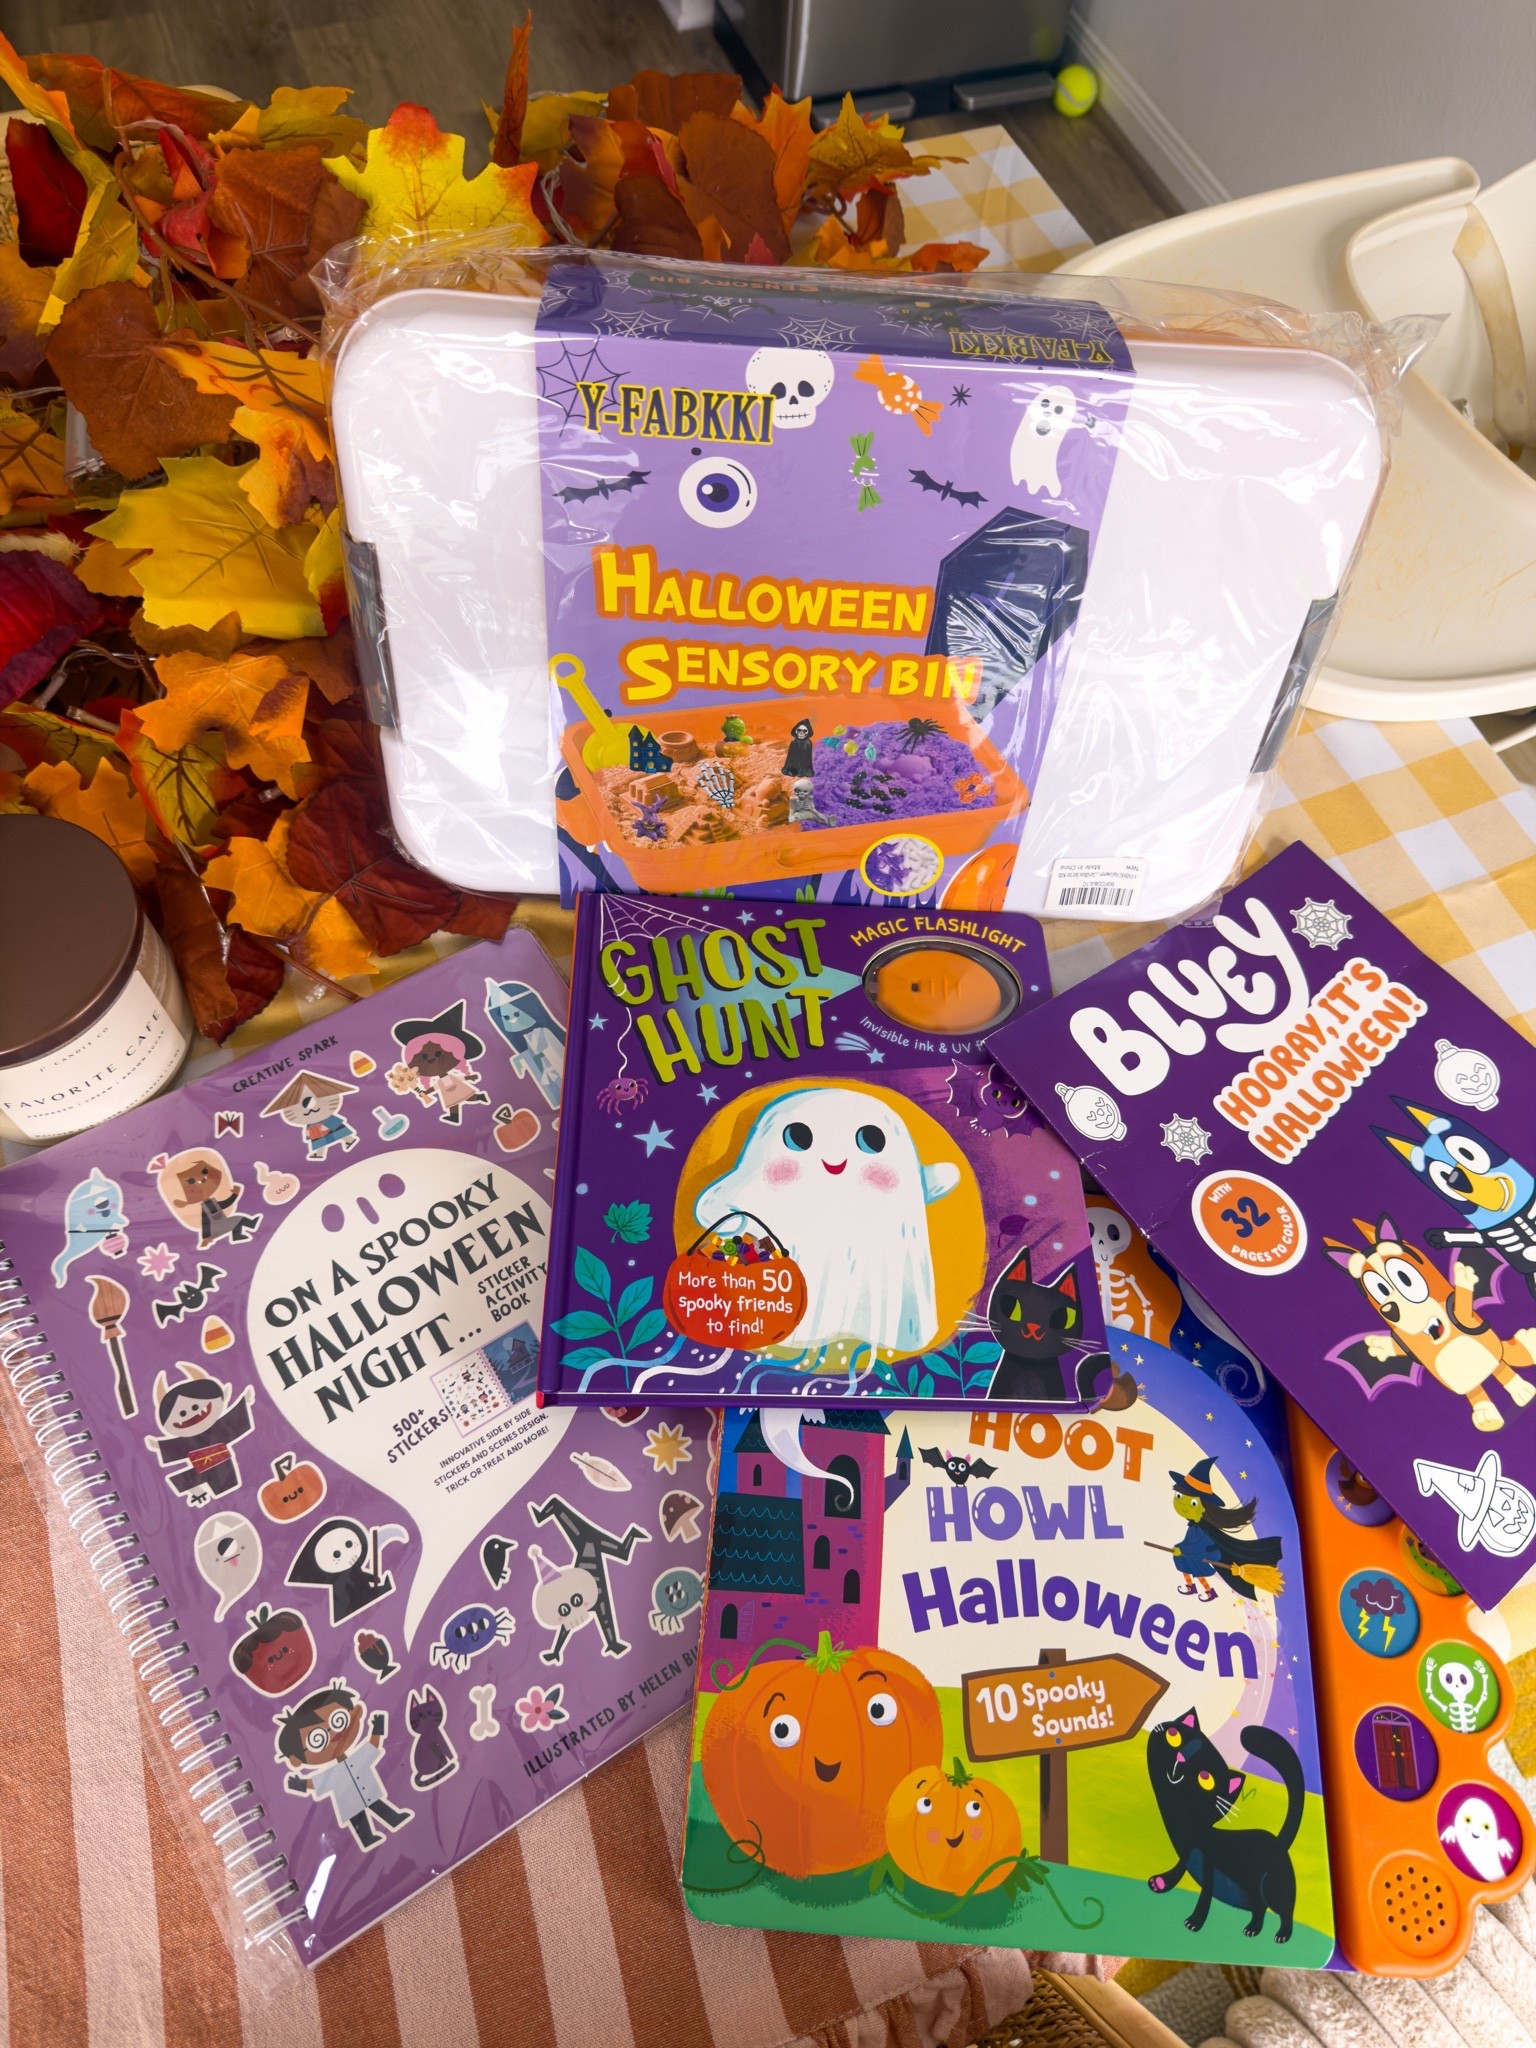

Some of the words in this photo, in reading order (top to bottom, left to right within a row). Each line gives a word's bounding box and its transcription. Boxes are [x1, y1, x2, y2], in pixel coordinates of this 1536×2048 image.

[949, 331, 1115, 364] Y-FABKKI
[576, 381, 776, 445] Y-FABKKI
[596, 547, 931, 635] HALLOWEEN
[622, 640, 877, 703] SENSORY
[887, 654, 983, 702] BIN
[600, 917, 827, 1006] GHOST
[850, 917, 909, 947] MAGIC
[914, 916, 1027, 953] FLASHLIGHT
[1069, 897, 1309, 1096] BLUEY
[3, 1062, 118, 1110] FAVORITE
[126, 1009, 161, 1058] CAFE
[233, 1057, 294, 1093] CREATIVE
[298, 1035, 339, 1062] SPARK
[635, 987, 833, 1083] HUNT
[859, 1016, 910, 1047] Invisible
[914, 1040, 934, 1053] ink
[938, 1042, 948, 1053] &
[952, 1041, 971, 1053] UV
[1219, 1012, 1339, 1126] HOORAY,
[1317, 962, 1383, 1025] IT'S
[1254, 987, 1421, 1160] HALLOWEEN!
[1208, 1182, 1233, 1204] WITH
[1220, 1195, 1271, 1238] 32
[264, 1278, 323, 1328] ON
[331, 1258, 361, 1296] A
[359, 1172, 500, 1275] SPOOKY
[1231, 1244, 1273, 1263] PAGES
[1271, 1243, 1288, 1258] TO
[1276, 1205, 1294, 1245] COLOR
[266, 1200, 546, 1392] HALLOWEEN
[477, 1255, 531, 1295] STICKER
[484, 1261, 547, 1309] ACTIVITY
[678, 1271, 717, 1289] More
[721, 1271, 756, 1290] than
[762, 1268, 793, 1293] 50
[490, 1292, 531, 1323] BOOK
[678, 1293, 732, 1318] spooky
[736, 1295, 794, 1314] friends
[706, 1317, 723, 1334] to
[728, 1316, 764, 1337] find!
[387, 1405, 454, 1464] STICKERS!
[392, 1407, 425, 1438] 500+
[433, 1460, 471, 1487] STICKERS
[471, 1449, 489, 1464] AND
[488, 1431, 518, 1453] SCENES
[519, 1412, 549, 1435] DESIGN.
[439, 1436, 486, 1469] INNOVATIVE
[485, 1425, 504, 1440] SIDE
[503, 1419, 514, 1430] BY
[514, 1407, 532, 1423] SIDE
[968, 1411, 1155, 1483] HOOT
[445, 1475, 470, 1494] TRICK
[470, 1467, 483, 1479] OR
[482, 1452, 506, 1471] TREAT
[506, 1441, 524, 1457] AND
[523, 1425, 550, 1446] MORE!
[925, 1484, 1125, 1543] HOWL
[901, 1558, 1259, 1680] Halloween
[522, 1707, 616, 1778] ILLUSTRATED
[617, 1689, 637, 1713] BY
[638, 1659, 683, 1697] HELEN
[975, 1683, 1019, 1725] 10
[1021, 1675, 1107, 1712] Spooky
[1031, 1706, 1115, 1737] Sounds!
